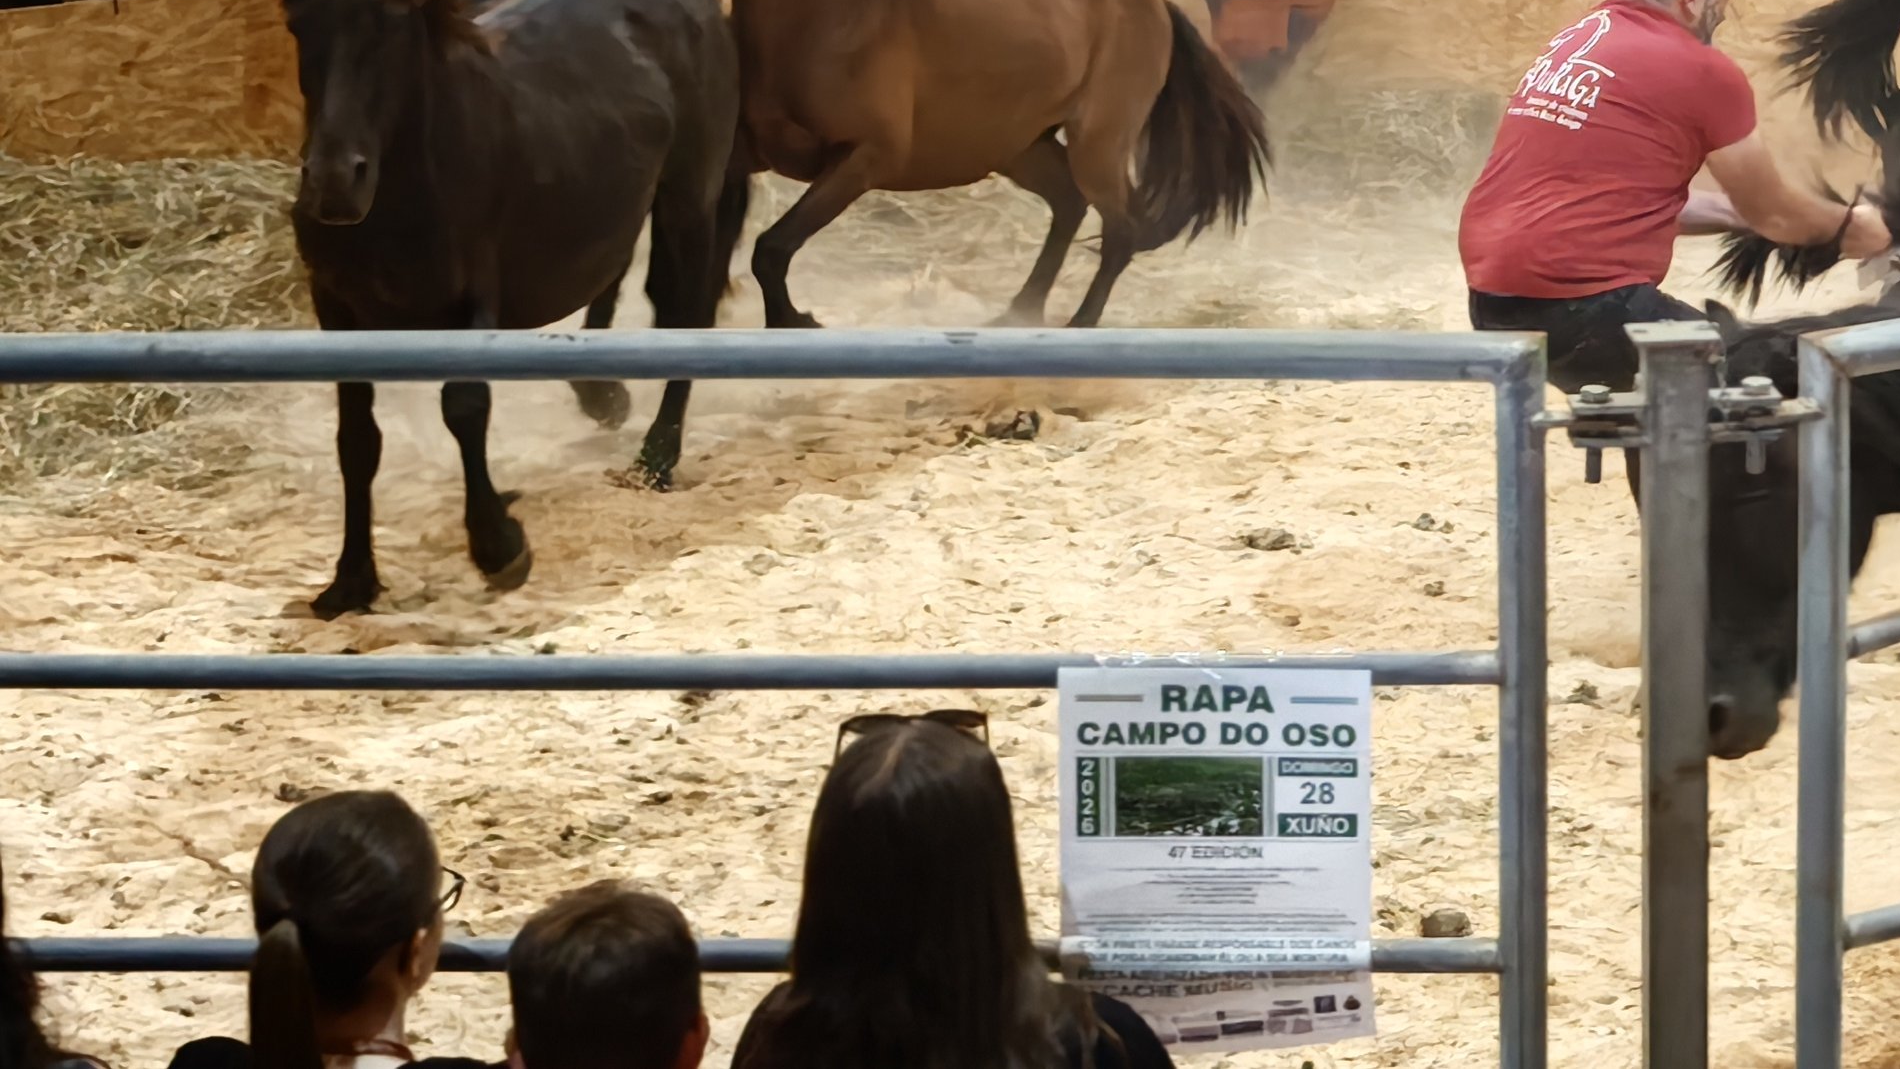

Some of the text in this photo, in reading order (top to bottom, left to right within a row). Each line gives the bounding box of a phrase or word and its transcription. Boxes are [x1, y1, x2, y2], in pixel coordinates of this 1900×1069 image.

[1160, 684, 1275, 713] RAPA
[1077, 721, 1357, 748] CAMPO DO OSO
[1300, 782, 1335, 804] 28
[1285, 813, 1350, 834] XUÑO
